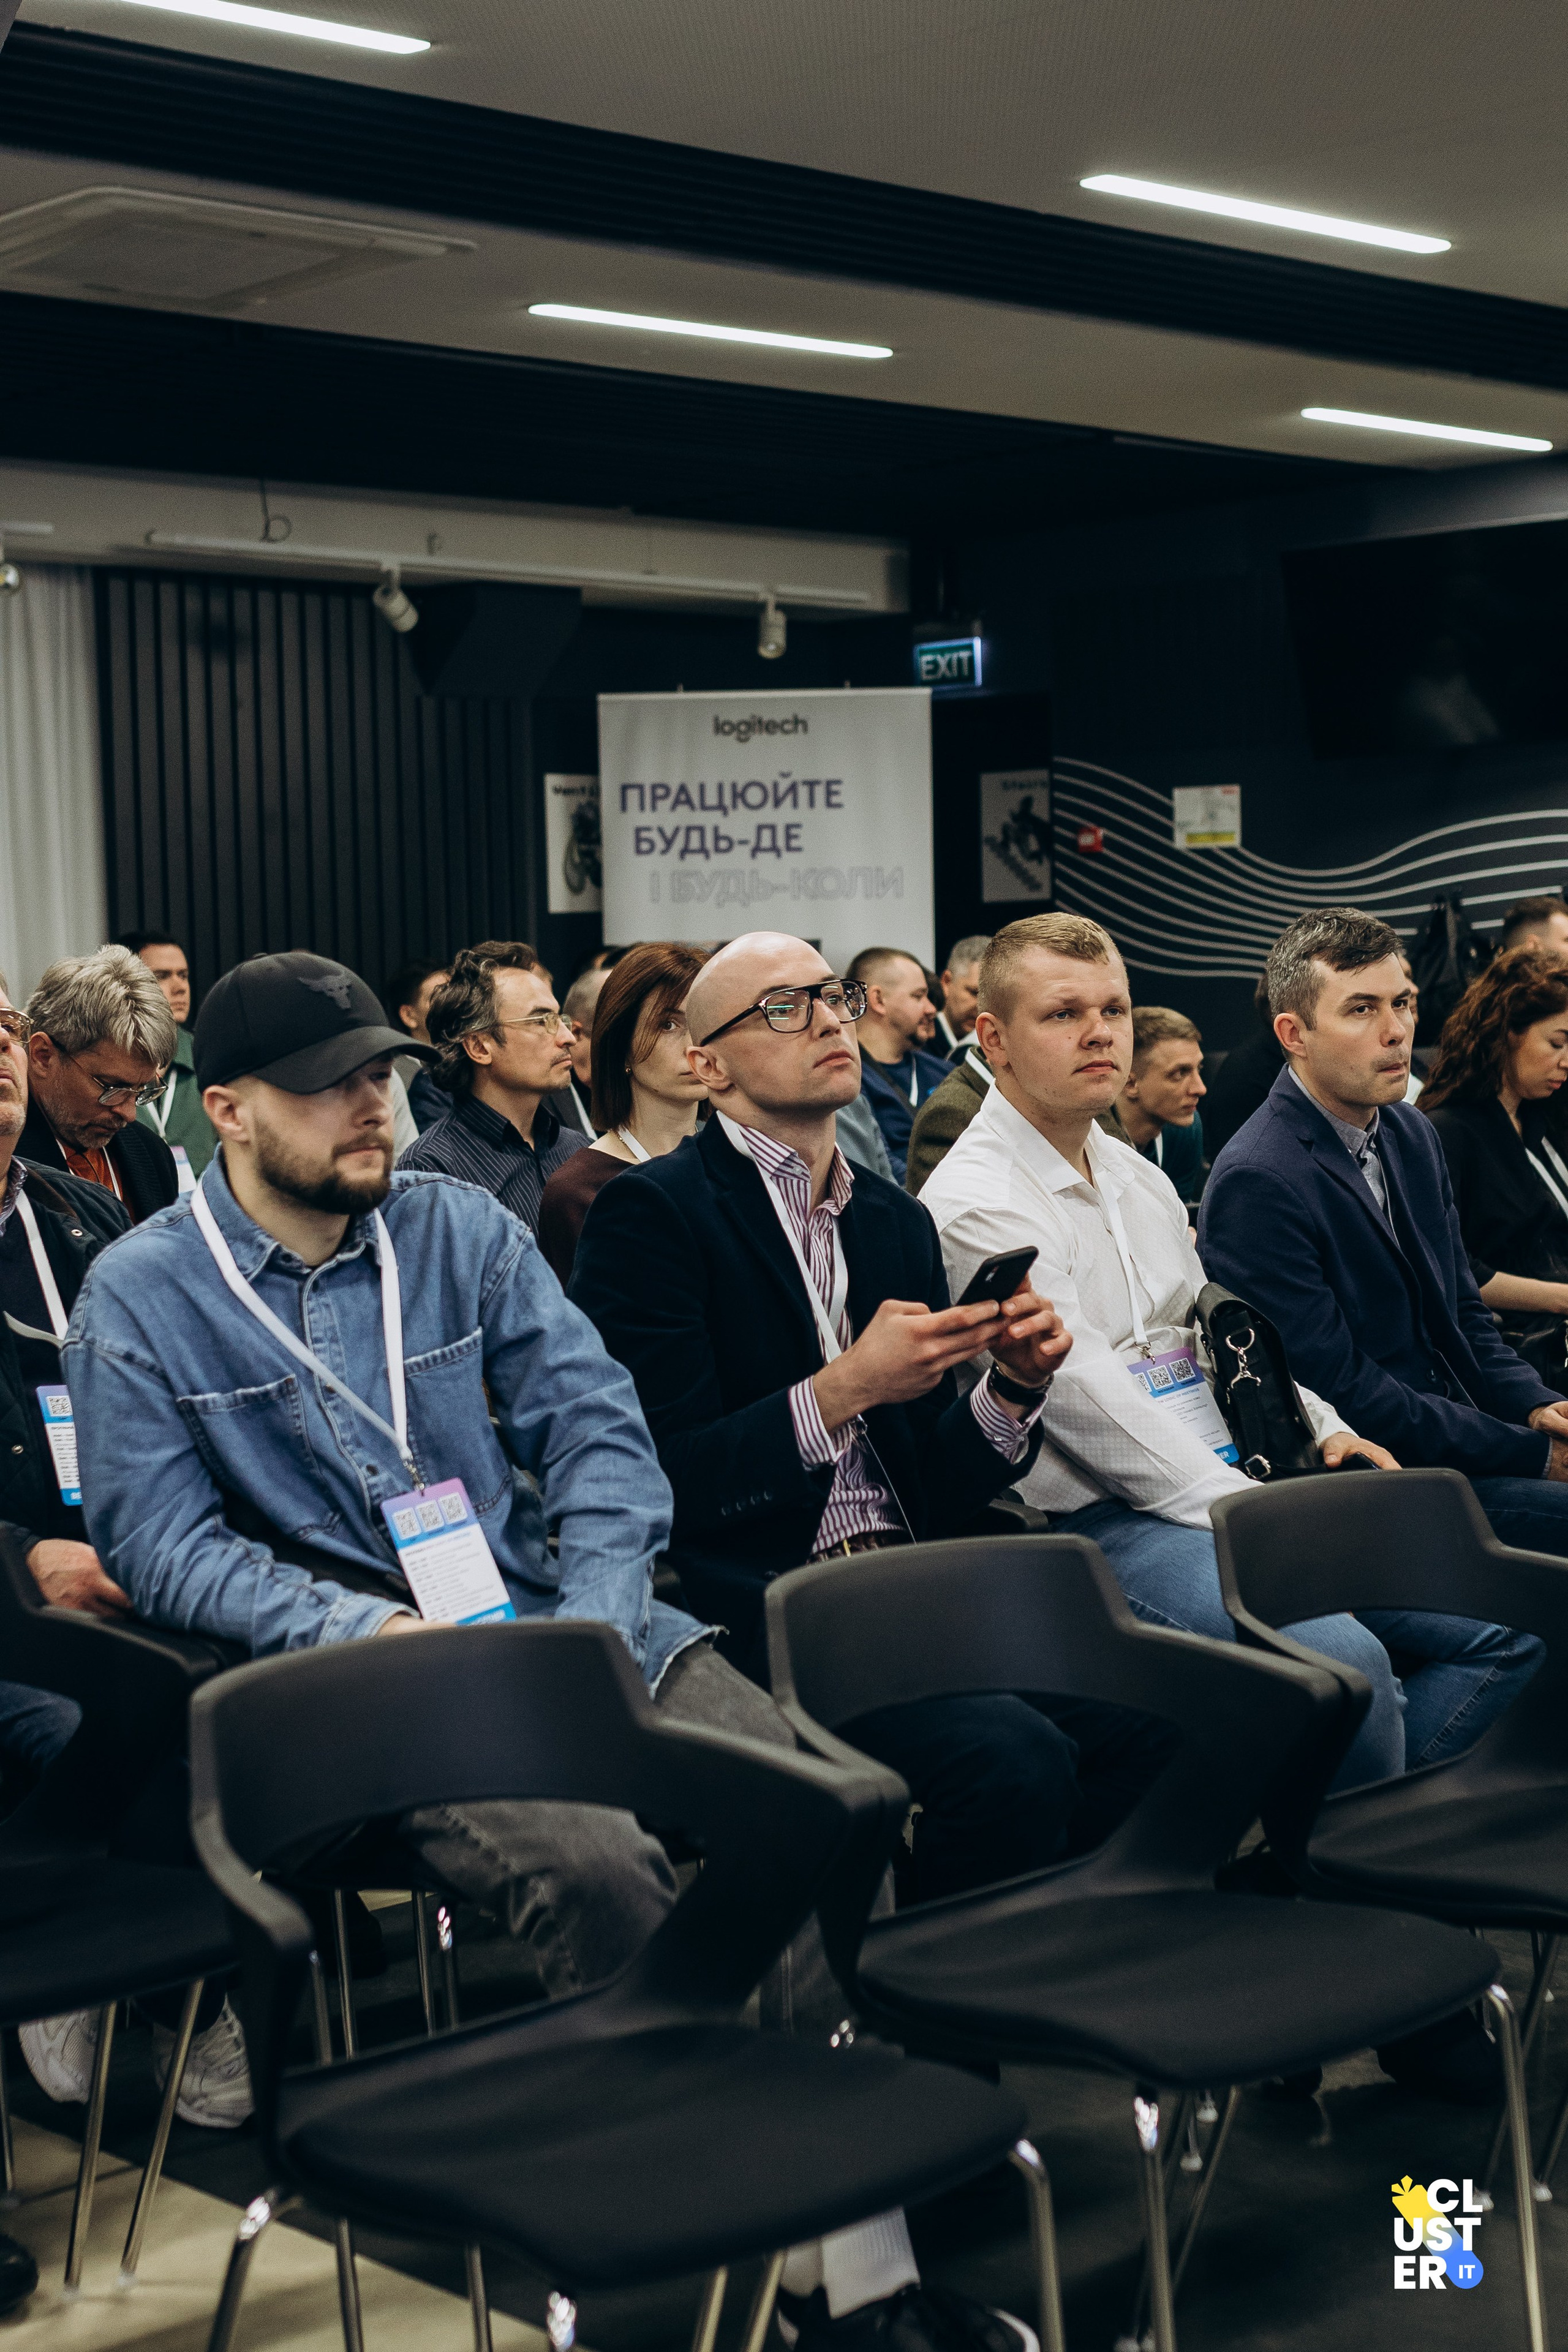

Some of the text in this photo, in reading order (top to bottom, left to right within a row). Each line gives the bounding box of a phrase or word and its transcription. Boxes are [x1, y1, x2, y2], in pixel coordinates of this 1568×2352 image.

[920, 650, 972, 680] EXIT
[714, 714, 809, 743] logitech
[620, 771, 844, 817] ПРАЦЮЙТЕ
[634, 824, 804, 861] БУДЬ-ДЕ
[670, 865, 904, 908] БУДЬ-КОЛИ
